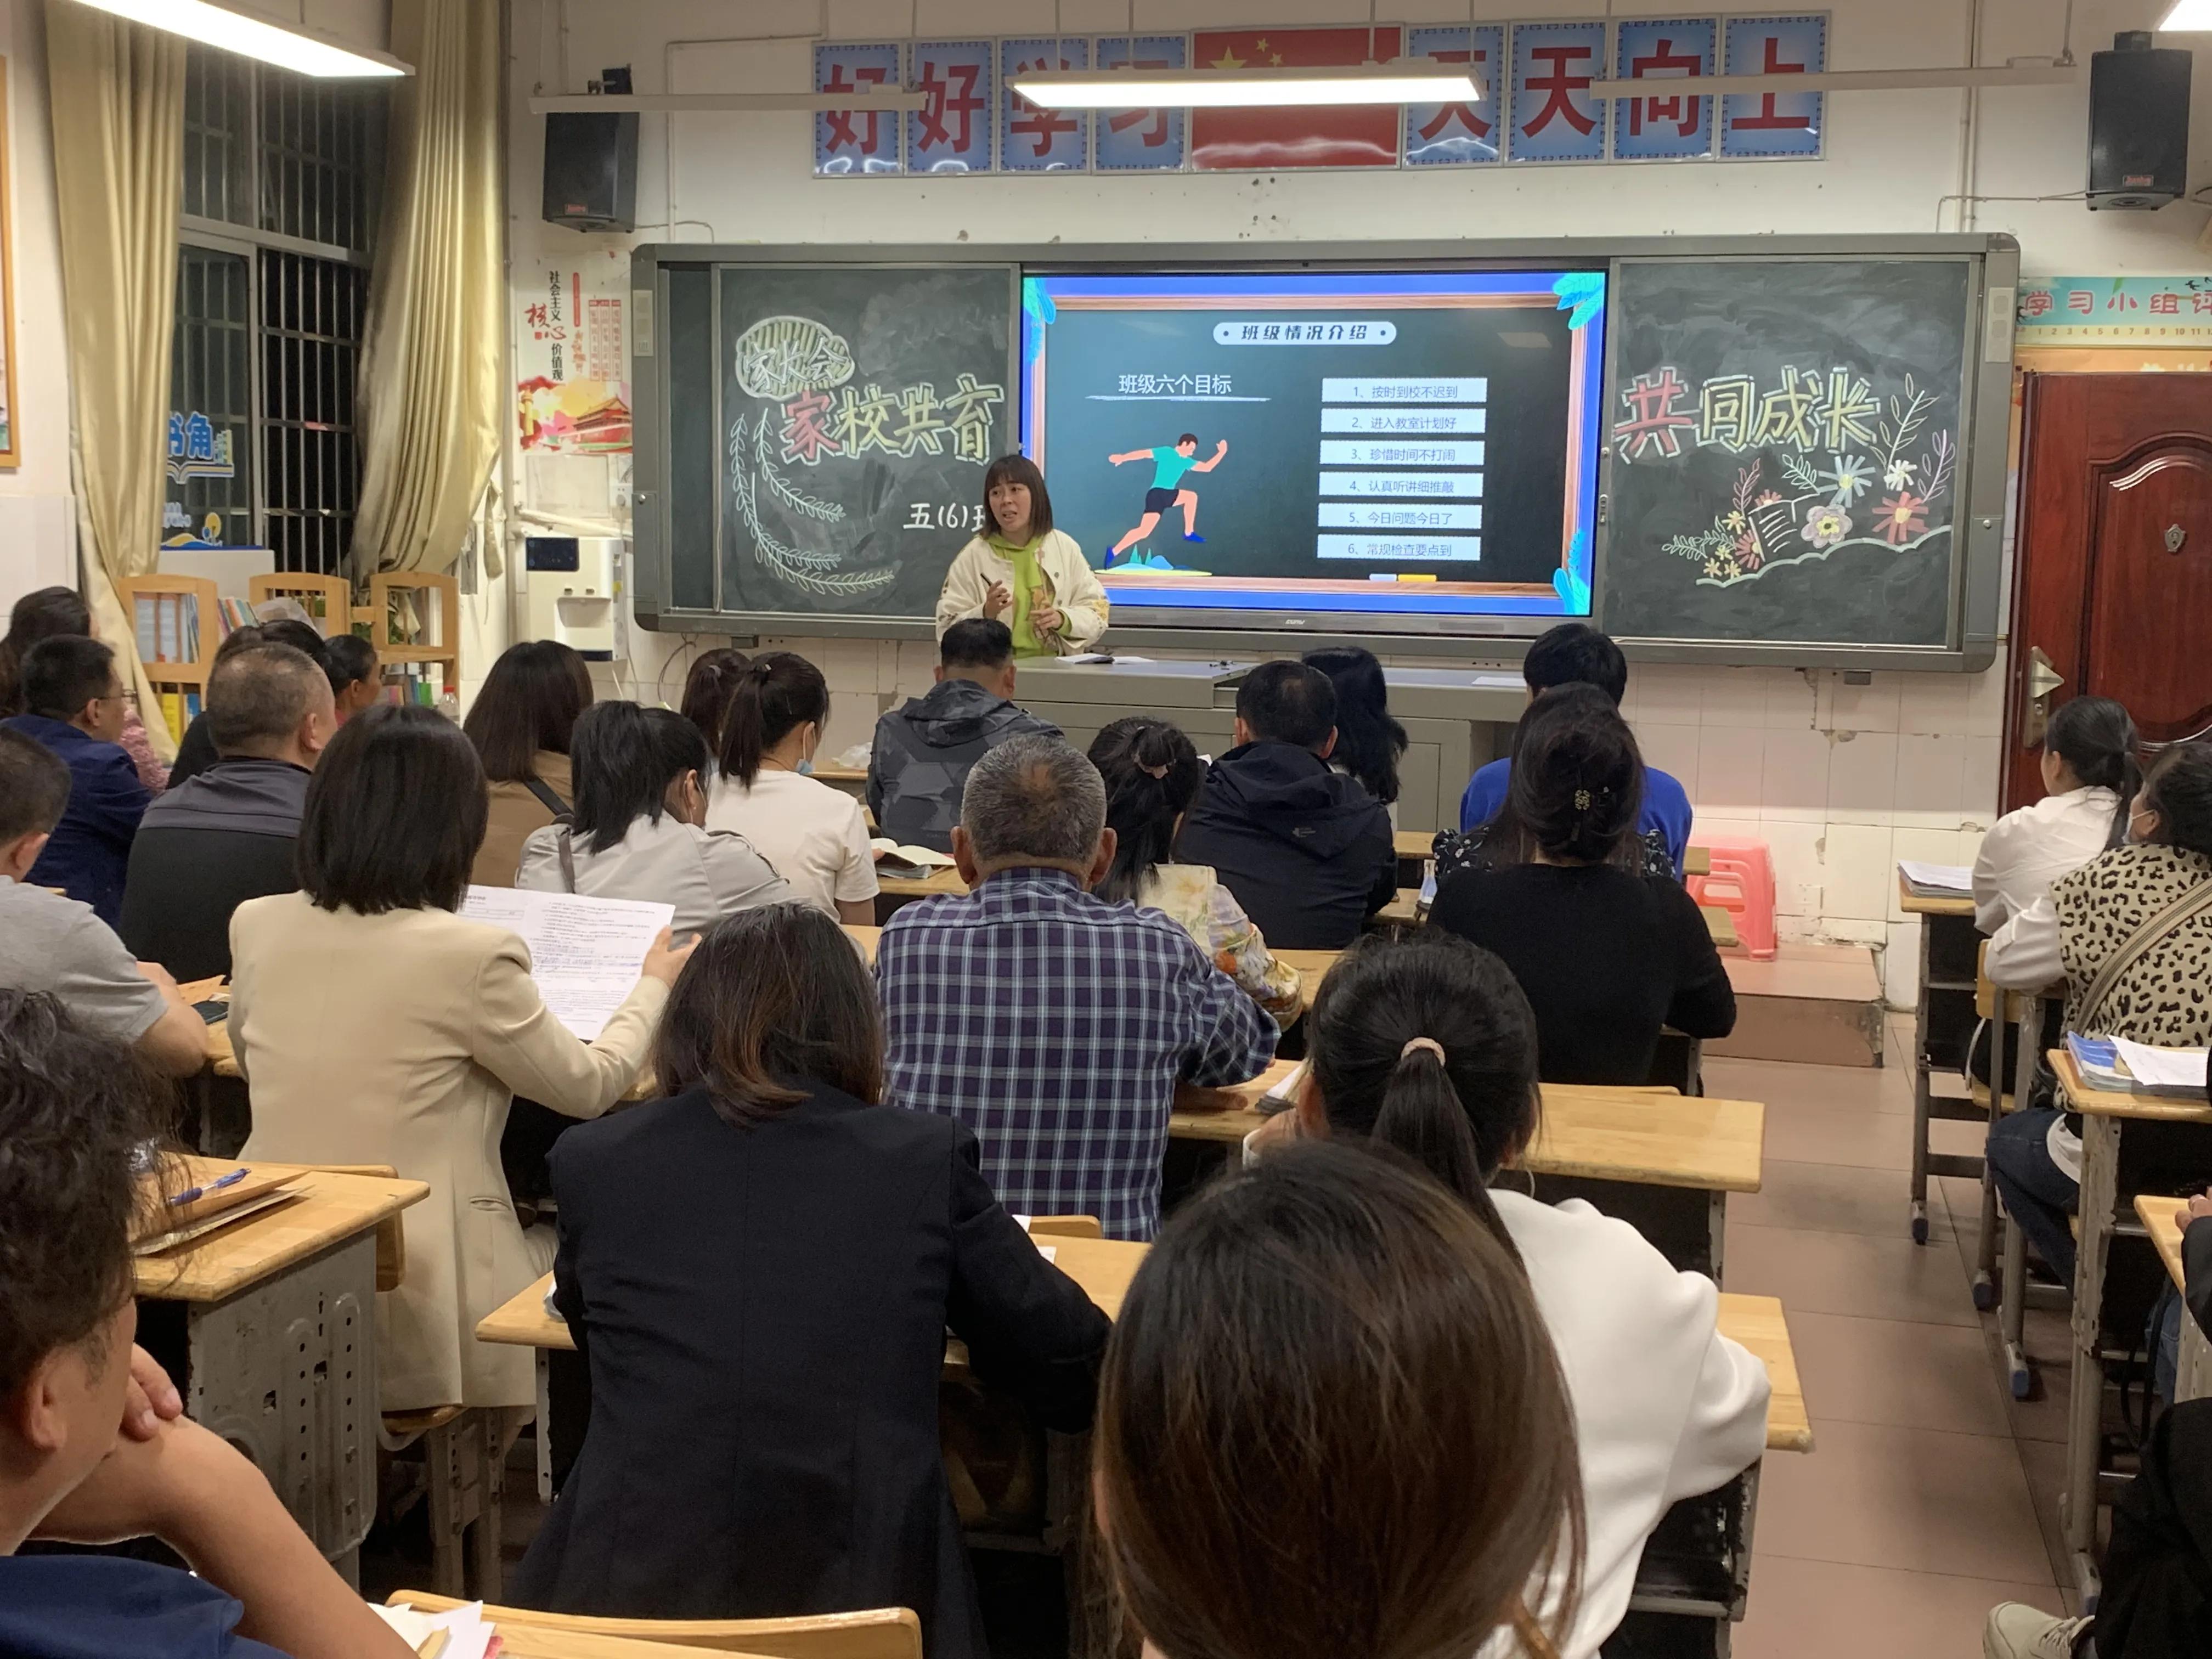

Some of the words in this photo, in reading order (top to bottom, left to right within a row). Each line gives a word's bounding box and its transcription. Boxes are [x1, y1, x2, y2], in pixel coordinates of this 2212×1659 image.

[550, 270, 561, 321] 社会主义
[1240, 324, 1367, 340] 班级情况介绍
[551, 343, 563, 381] 价值观
[1118, 374, 1232, 394] 班级六个目标
[780, 373, 1005, 466] 家校共育
[1613, 365, 1881, 464] 共同成长
